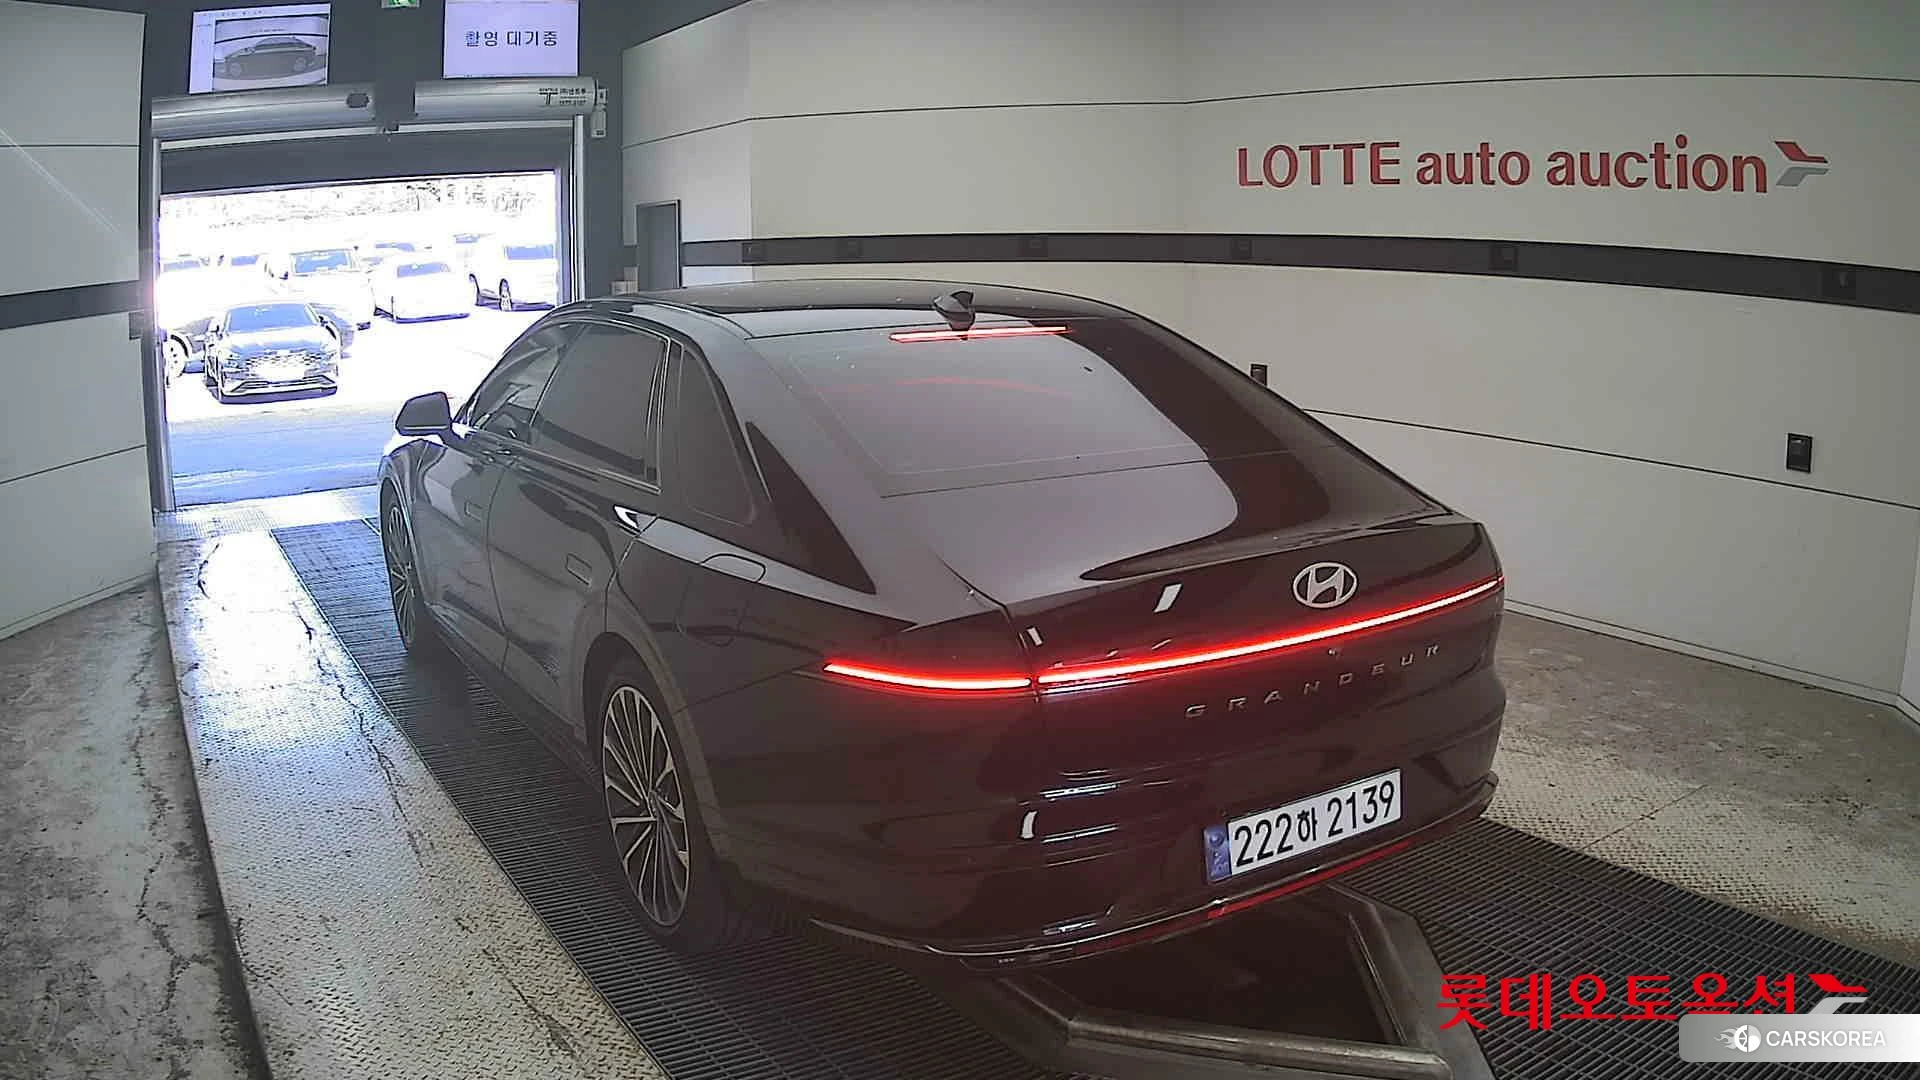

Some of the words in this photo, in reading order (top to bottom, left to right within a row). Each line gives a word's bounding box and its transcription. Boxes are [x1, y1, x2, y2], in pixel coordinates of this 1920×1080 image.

[506, 30, 557, 47] 대기중
[1238, 142, 1401, 188] LOTTE
[1415, 142, 1531, 186] auto
[1546, 134, 1769, 193] auction
[1185, 645, 1439, 718] GRANDEUR
[1327, 780, 1395, 838] 2139
